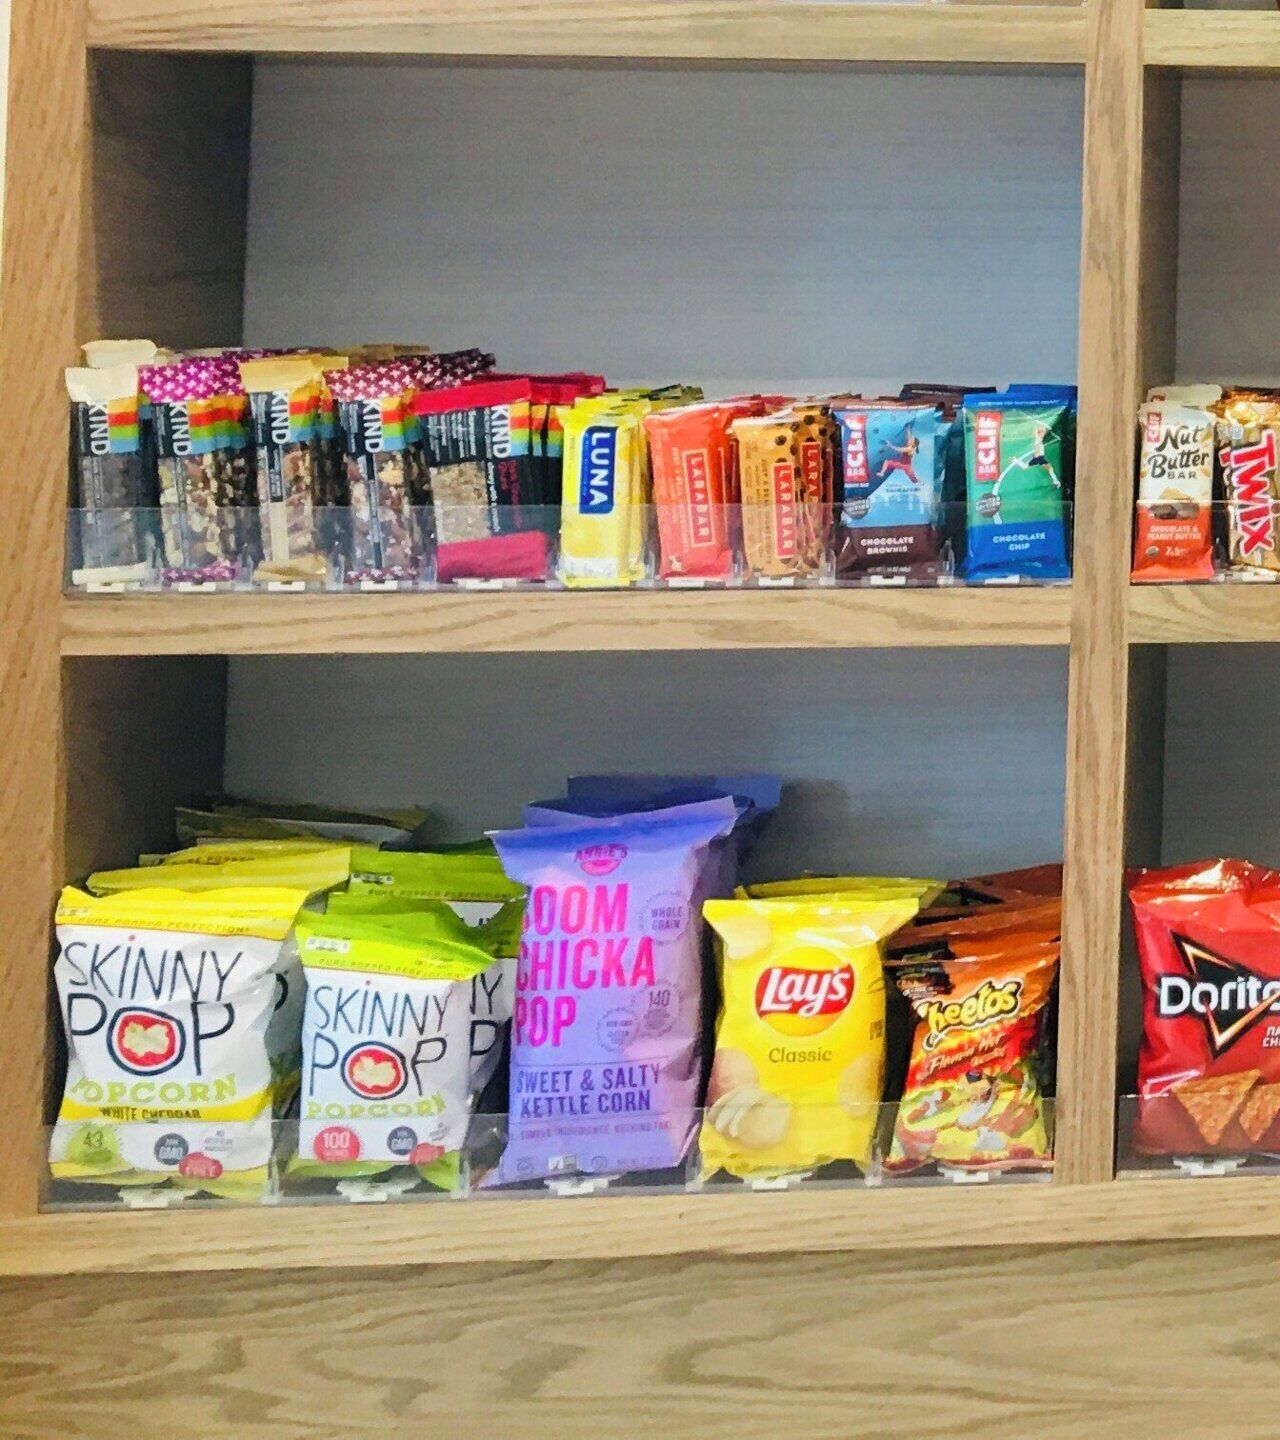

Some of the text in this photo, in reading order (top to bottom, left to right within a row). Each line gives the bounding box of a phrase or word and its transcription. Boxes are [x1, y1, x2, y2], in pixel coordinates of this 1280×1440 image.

[88, 400, 110, 455] KIND
[169, 402, 189, 456] KIND
[270, 390, 290, 445] KIND
[363, 398, 383, 454] KIND
[491, 405, 512, 458] KIND
[978, 415, 999, 465] CLIF
[1154, 424, 1204, 452] Nut
[589, 430, 611, 506] LUNA
[1147, 449, 1210, 479] Butter
[1167, 471, 1198, 479] BAR
[690, 457, 709, 537] LARABAR
[779, 470, 793, 549] LARABAR
[860, 537, 914, 546] CHOCOLATE
[867, 546, 908, 555] BROWNIE
[993, 532, 1046, 544] CHOCOLATE
[63, 934, 243, 1003] SKINNY
[760, 967, 851, 1018] Lay's
[313, 980, 452, 1038] SKINNY
[513, 994, 578, 1049] POP
[647, 989, 670, 1008] 140
[67, 992, 235, 1077] POP
[768, 1046, 832, 1064] Classic
[309, 1031, 447, 1099] POP
[515, 1063, 660, 1096] SWEET & SALTY
[307, 1093, 446, 1119] POPCORN
[520, 1089, 651, 1119] KETTLE CORN
